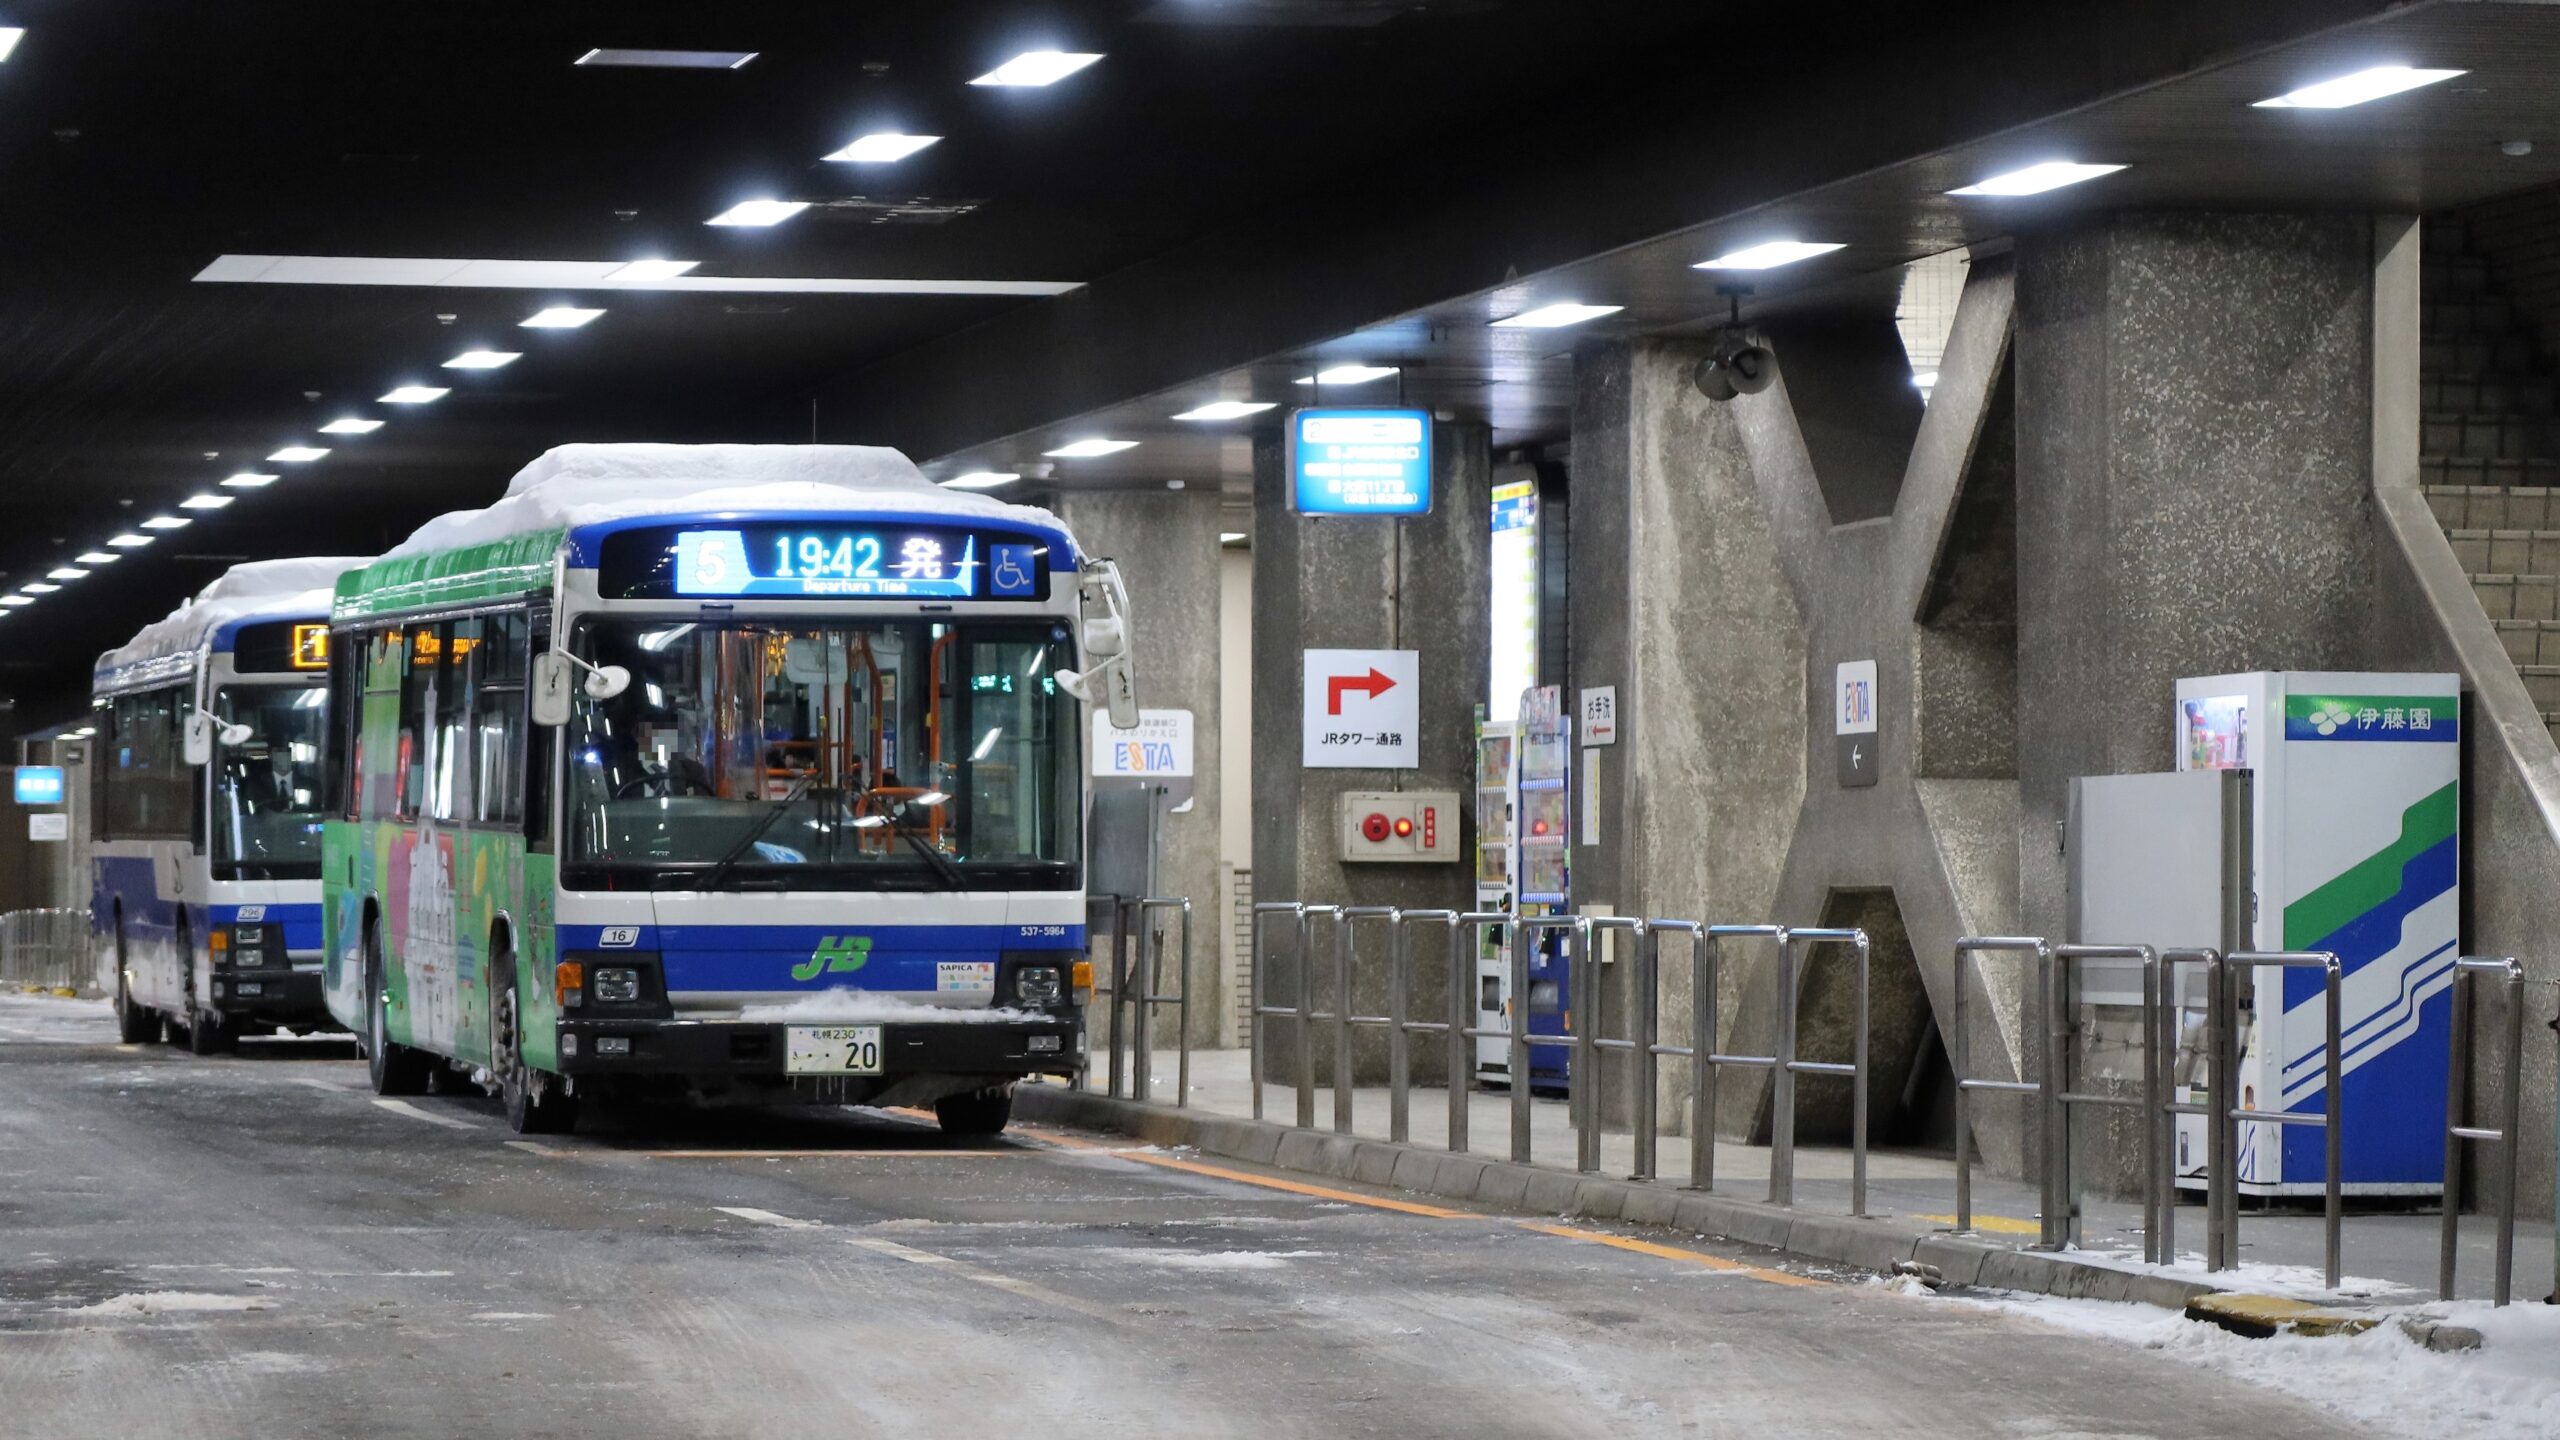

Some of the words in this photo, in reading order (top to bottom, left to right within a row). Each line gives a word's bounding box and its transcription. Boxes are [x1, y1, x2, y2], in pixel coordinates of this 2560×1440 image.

[695, 540, 727, 585] 5
[775, 536, 881, 578] 19:42
[899, 537, 943, 579] 発
[803, 579, 871, 594] Departure
[876, 579, 908, 593] Time
[1845, 680, 1870, 724] ESTA
[2354, 706, 2432, 731] 伊藤園
[1321, 732, 1402, 746] JRタワー通路
[1115, 742, 1175, 772] ESTA
[611, 930, 627, 942] 16
